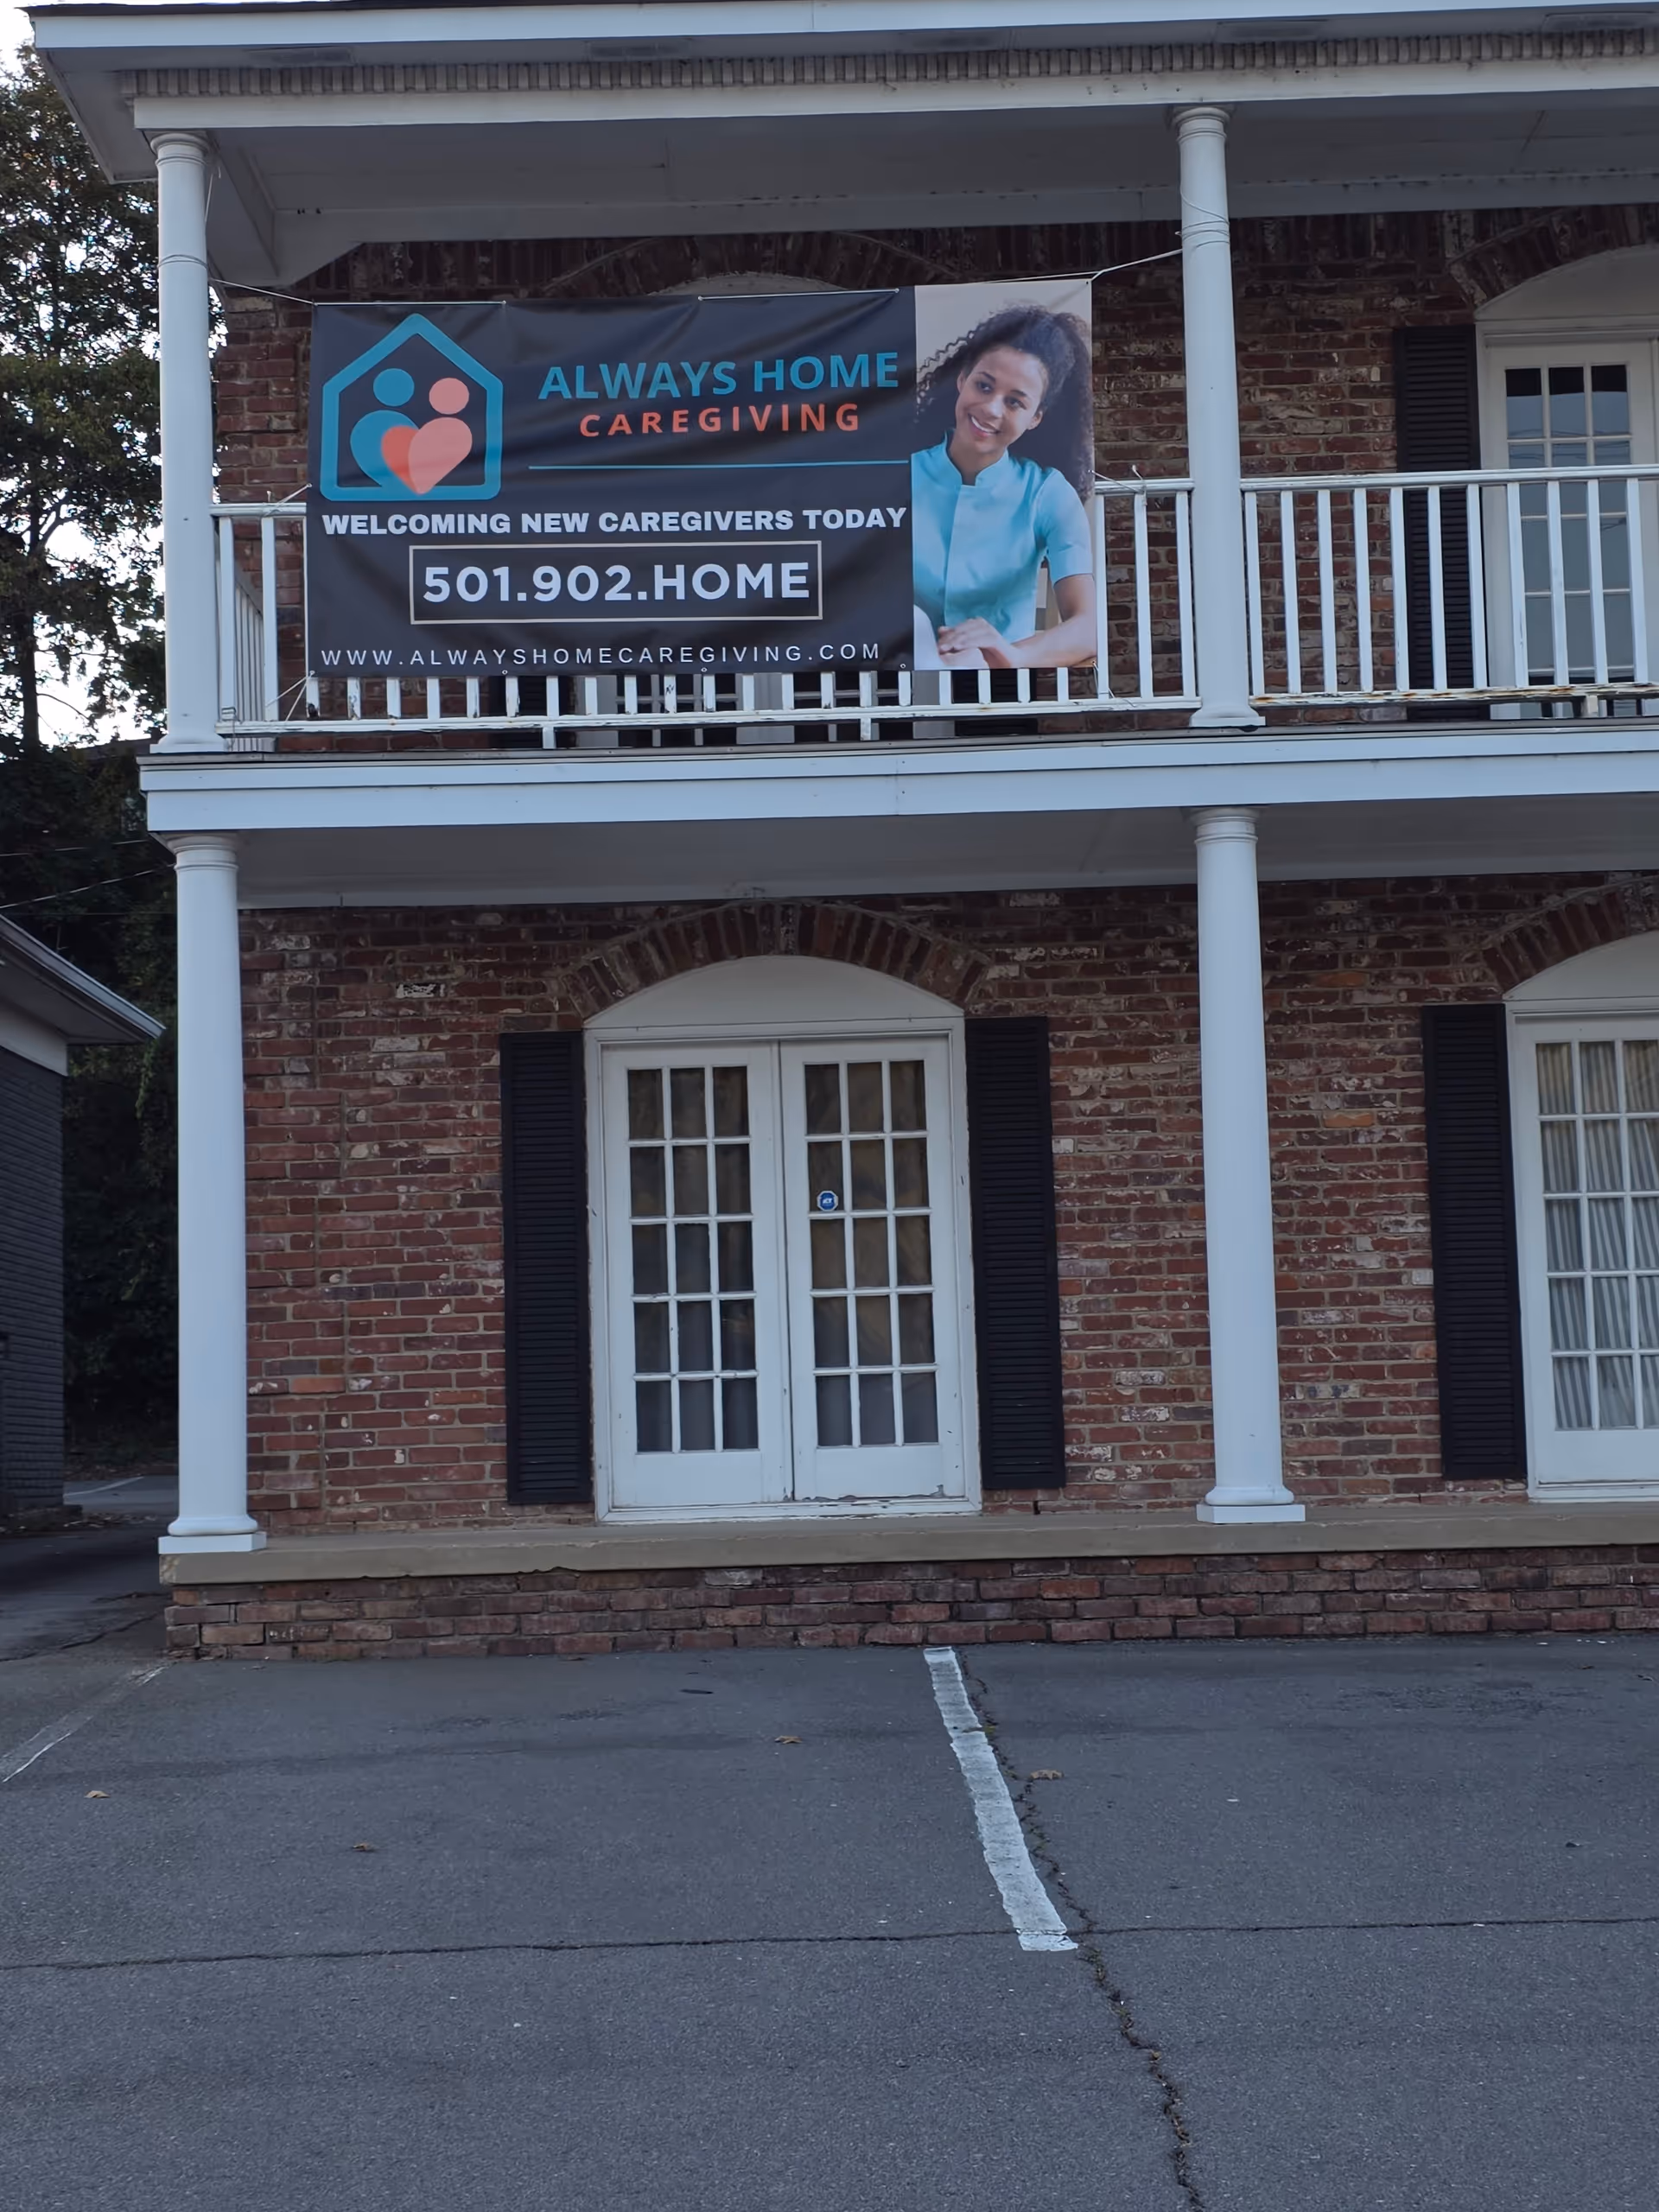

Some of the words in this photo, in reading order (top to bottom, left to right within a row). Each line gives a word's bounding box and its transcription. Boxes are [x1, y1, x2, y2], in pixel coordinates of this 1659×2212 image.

[538, 361, 736, 399] ALWAYS
[754, 352, 899, 392] HOME
[580, 403, 859, 437] CAREGIVING
[322, 513, 511, 535] WELCOMING
[522, 512, 589, 533] NEW
[599, 510, 793, 532] CAREGIVERS
[803, 507, 906, 530] TODAY
[423, 562, 810, 602] 501.902.HOME
[321, 643, 879, 665] WWW.ALWAYSHOMECAREGIVING.COM
